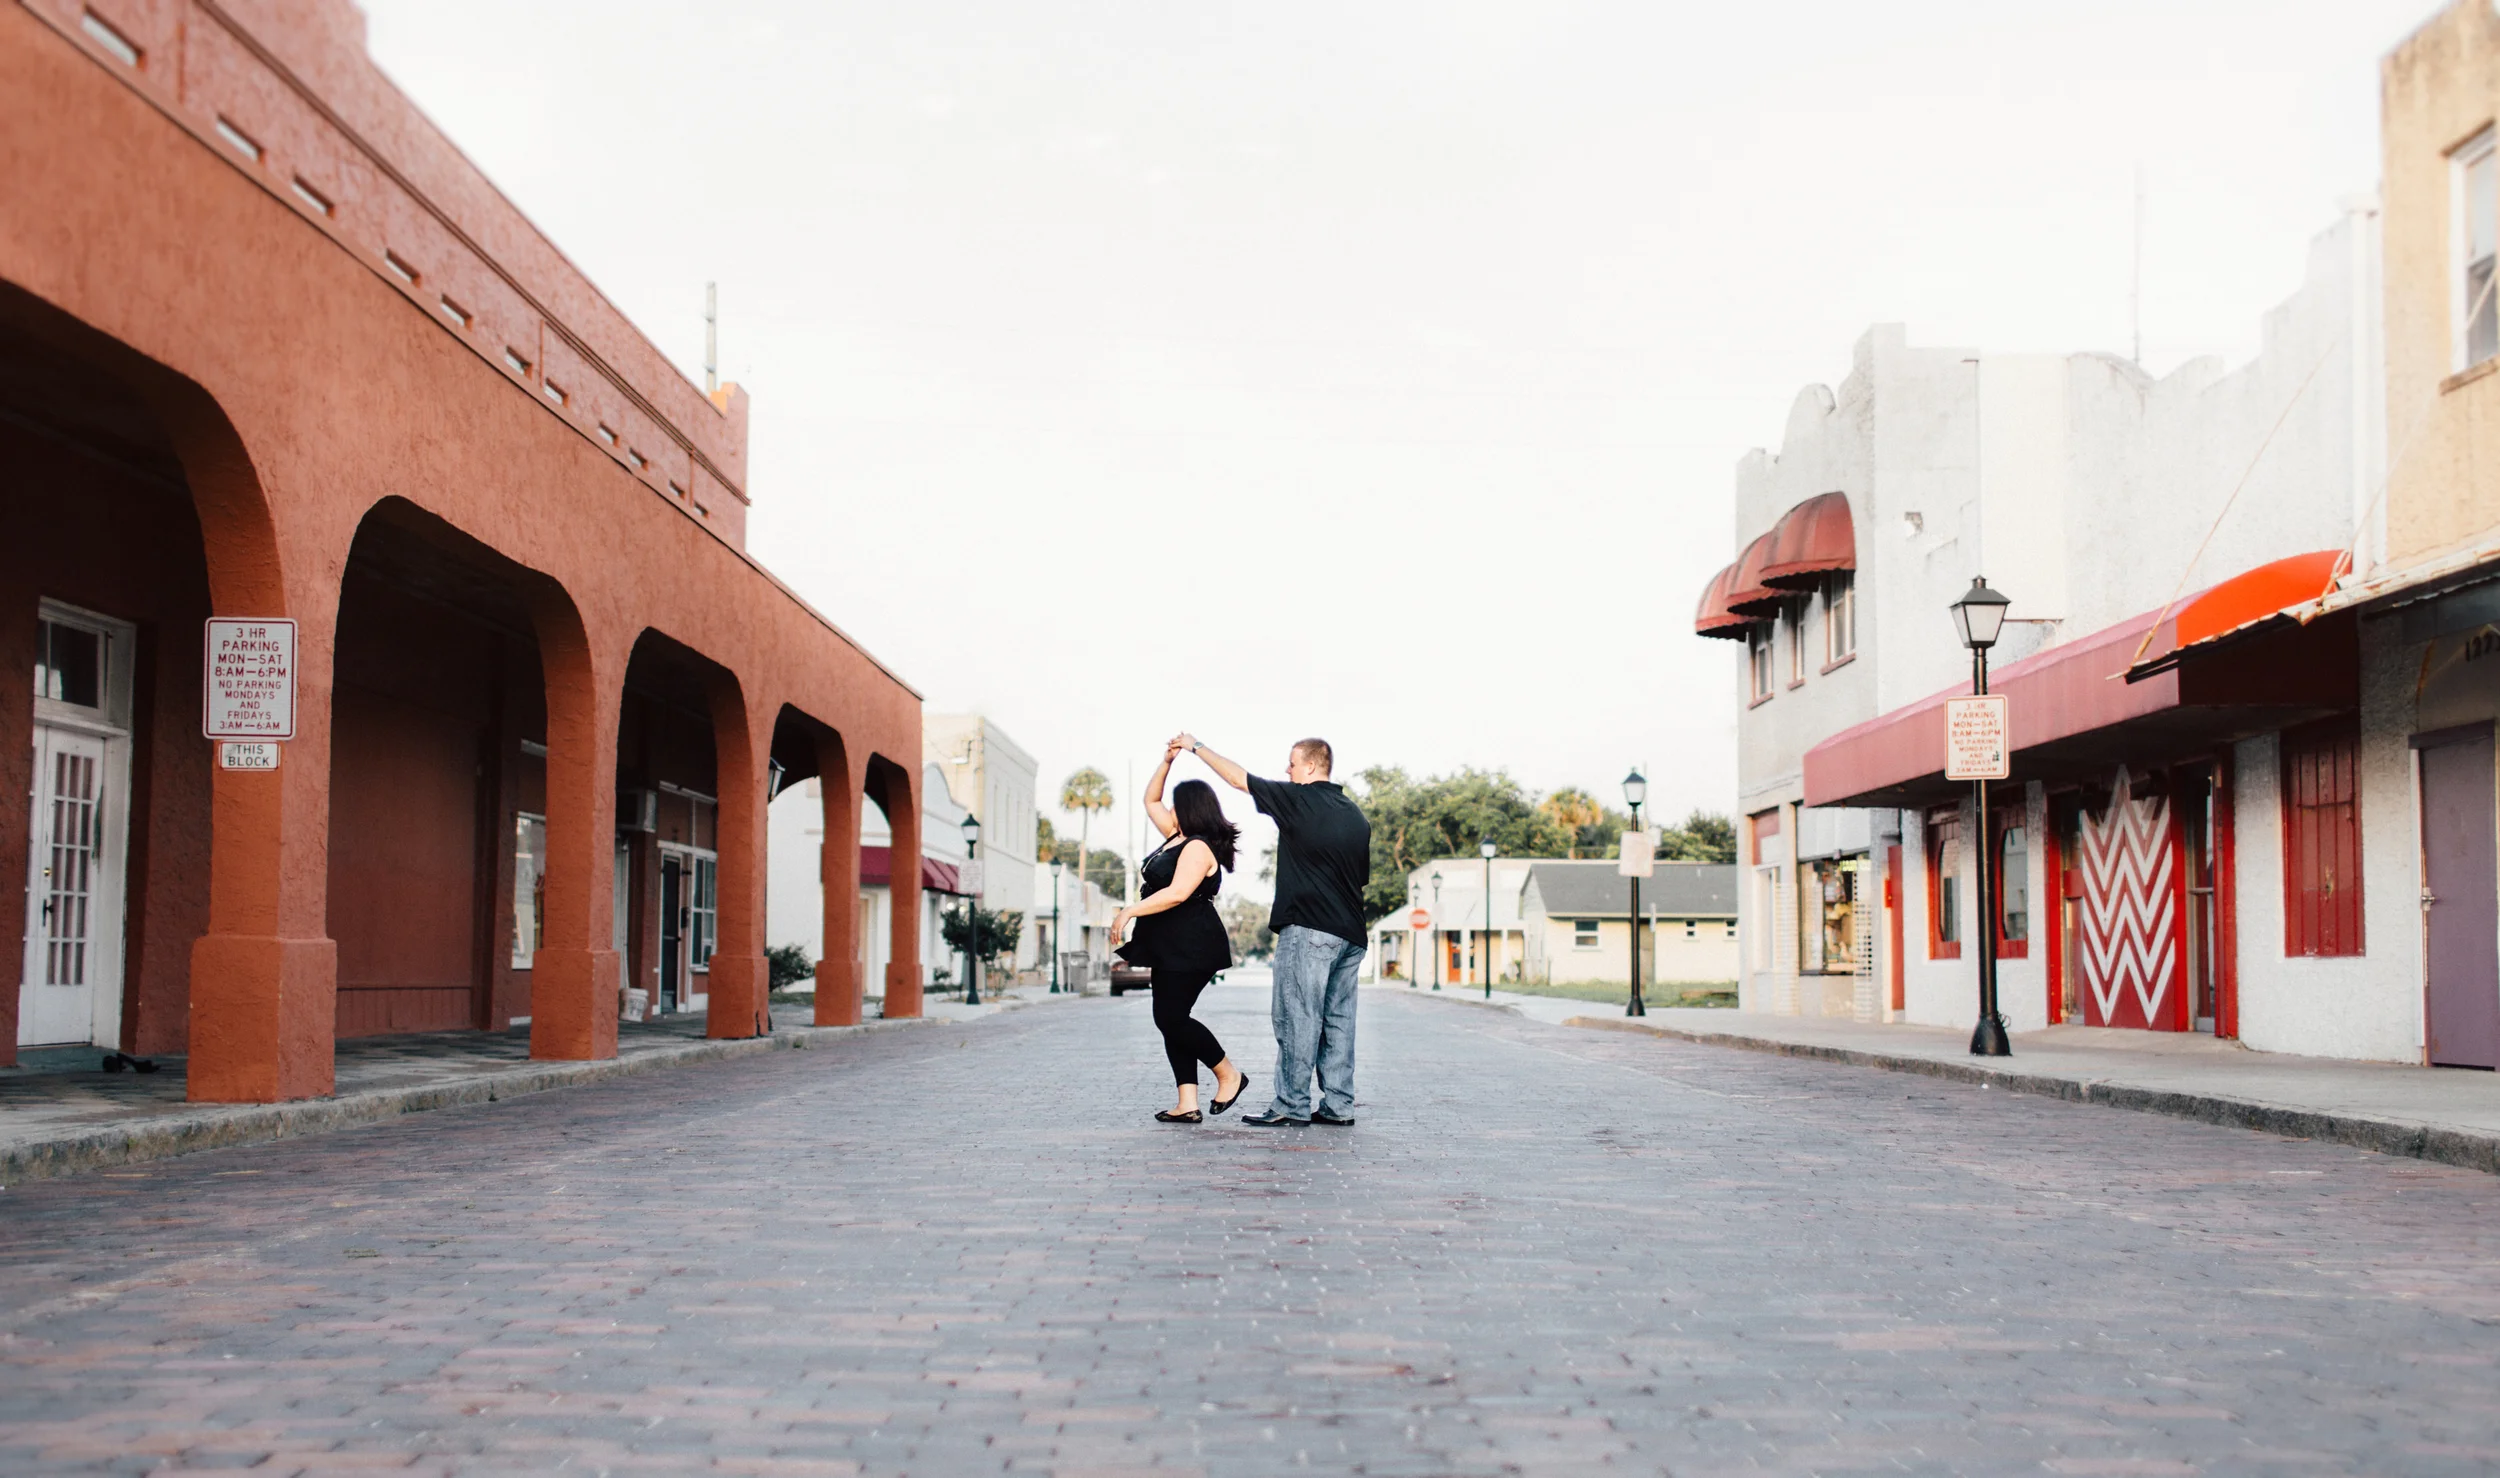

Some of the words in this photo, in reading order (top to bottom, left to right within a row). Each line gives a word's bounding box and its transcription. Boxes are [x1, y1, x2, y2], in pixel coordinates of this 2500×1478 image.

[236, 628, 244, 638] 3
[249, 628, 266, 638] HR
[222, 640, 280, 652] PARKING
[218, 679, 233, 689] NO
[236, 680, 282, 690] PARKING
[224, 690, 275, 700] MONDAYS
[240, 701, 261, 710] AND
[227, 710, 272, 720] FRIDAYS
[1956, 711, 1996, 719] PARKING
[235, 744, 264, 755] THIS
[227, 756, 270, 767] BLOCK
